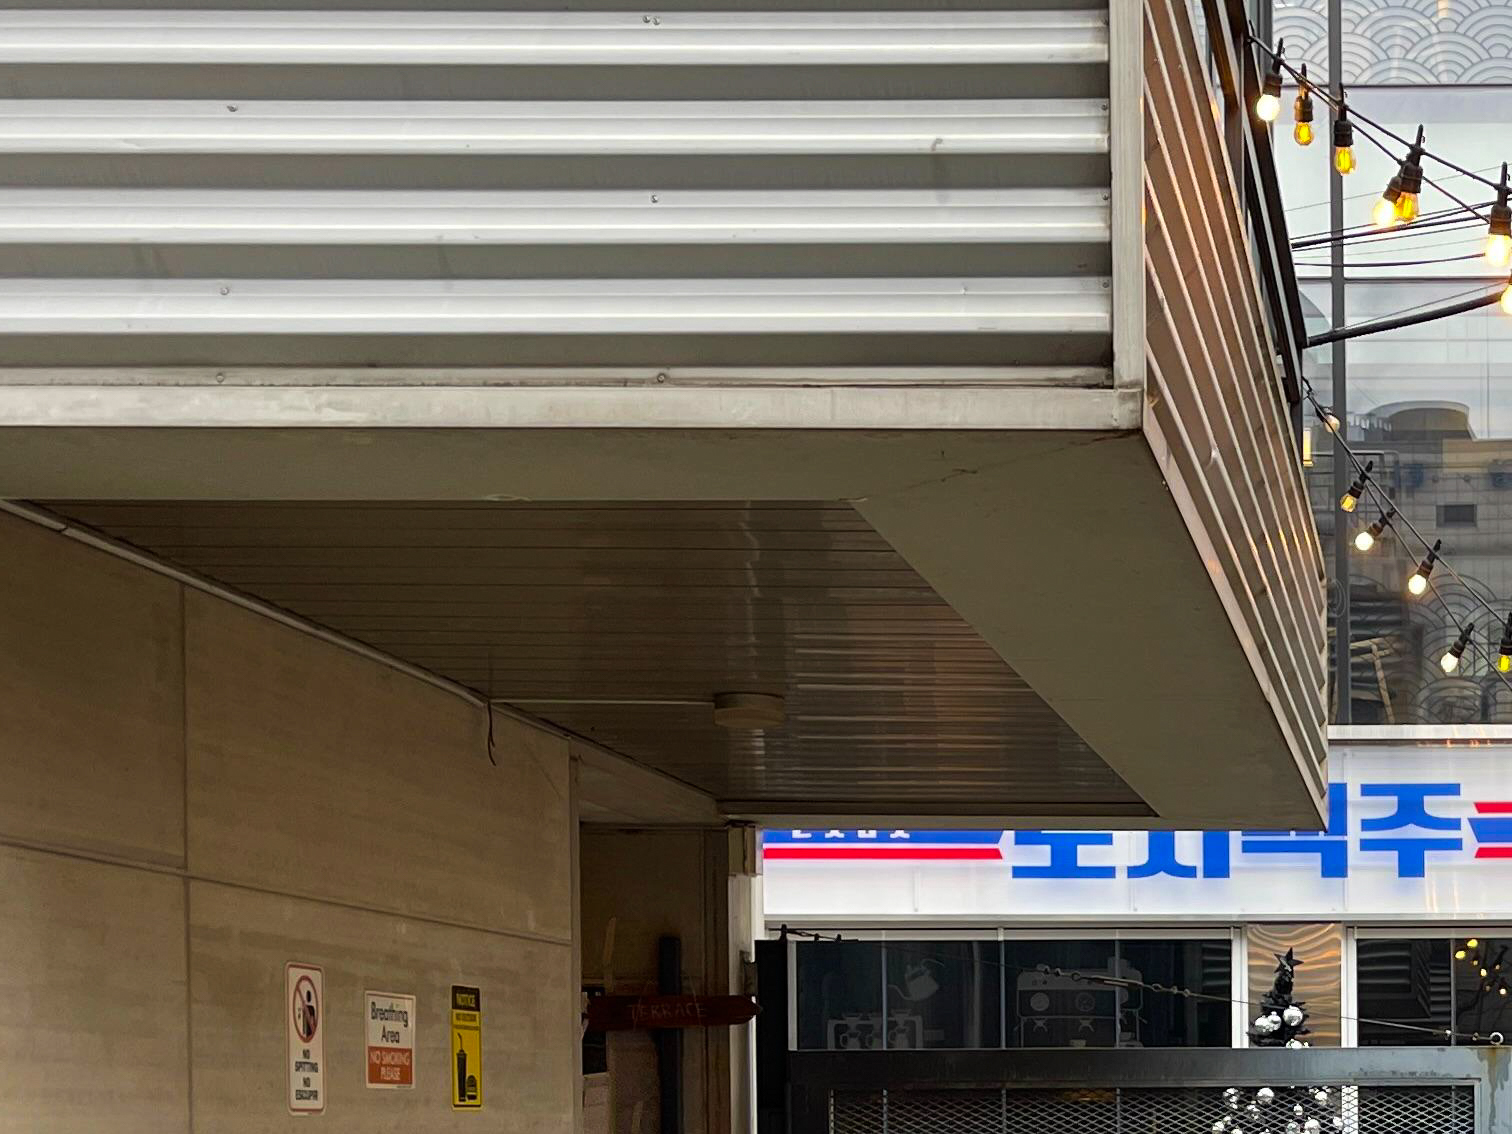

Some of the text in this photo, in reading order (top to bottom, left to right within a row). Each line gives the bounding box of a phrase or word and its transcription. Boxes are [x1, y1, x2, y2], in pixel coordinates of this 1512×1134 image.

[371, 1002, 409, 1028] Breathing
[381, 1026, 400, 1044] Area
[303, 1049, 311, 1060] NO
[369, 1050, 410, 1066] NO SMOKING
[381, 1067, 401, 1081] PLEASE
[303, 1077, 311, 1088] NO
